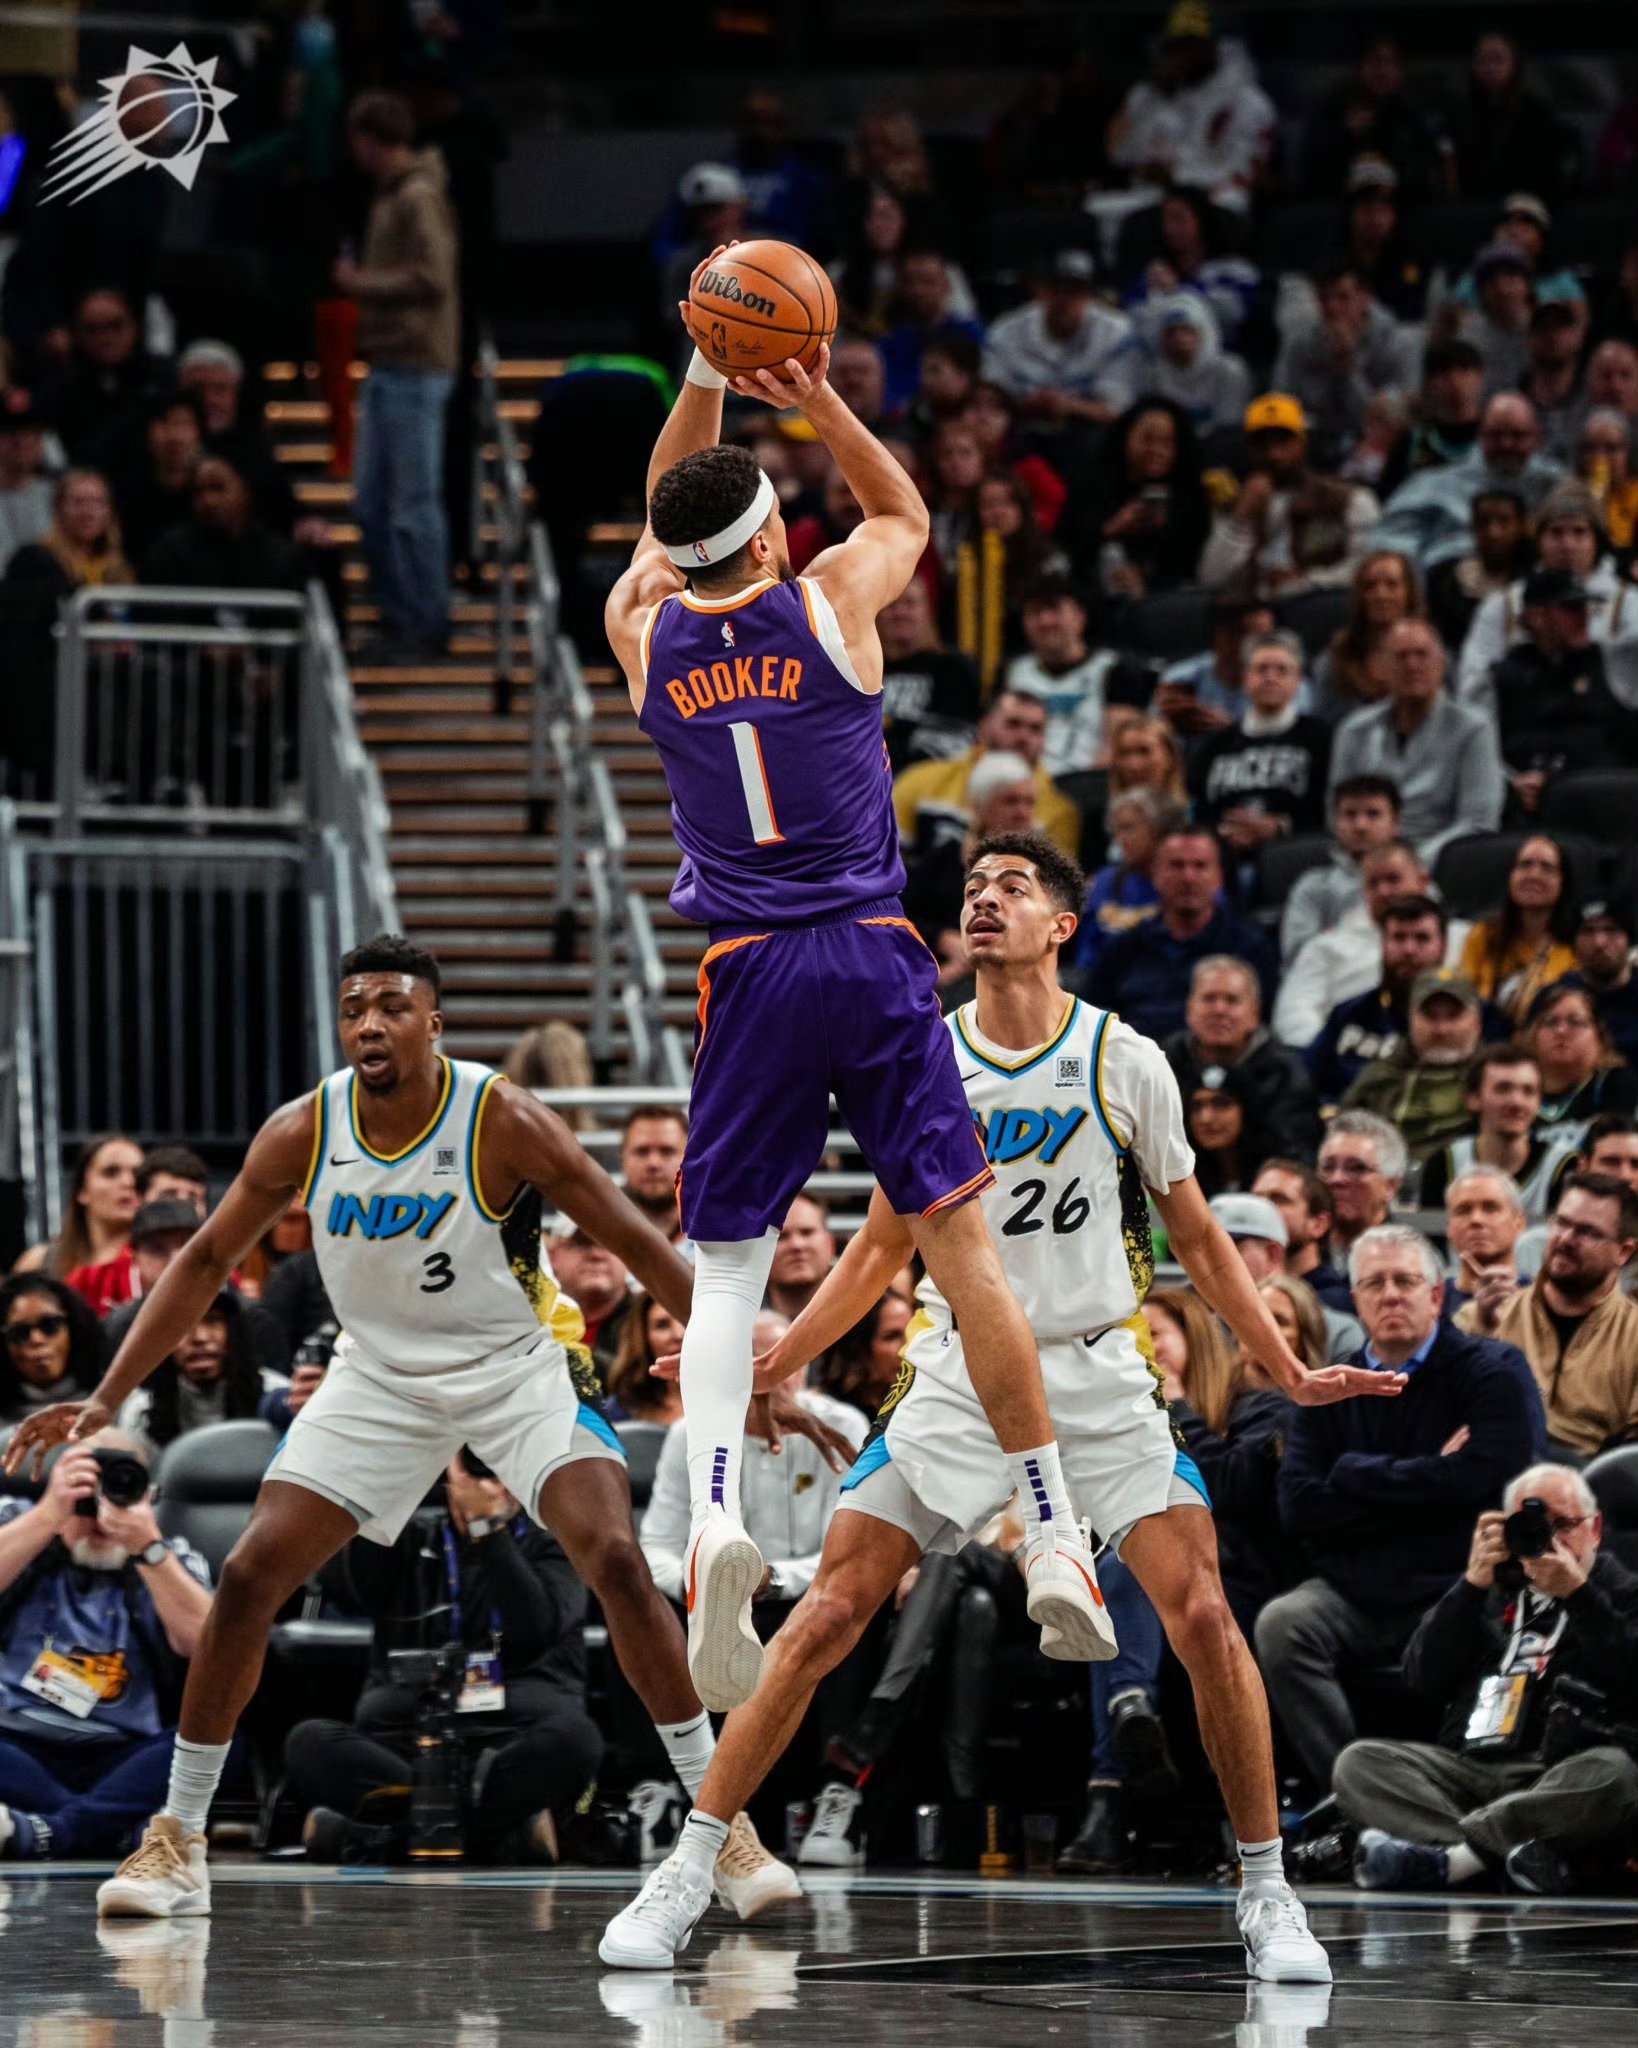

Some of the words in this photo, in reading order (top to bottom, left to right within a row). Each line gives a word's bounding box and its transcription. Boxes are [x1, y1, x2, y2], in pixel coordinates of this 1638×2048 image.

[698, 270, 777, 319] Wilson
[664, 655, 803, 720] BOOKER
[726, 721, 787, 846] 1
[970, 1104, 1089, 1167] NDY
[327, 1190, 459, 1240] INDY
[1001, 1176, 1091, 1236] 26
[420, 1251, 456, 1294] 3
